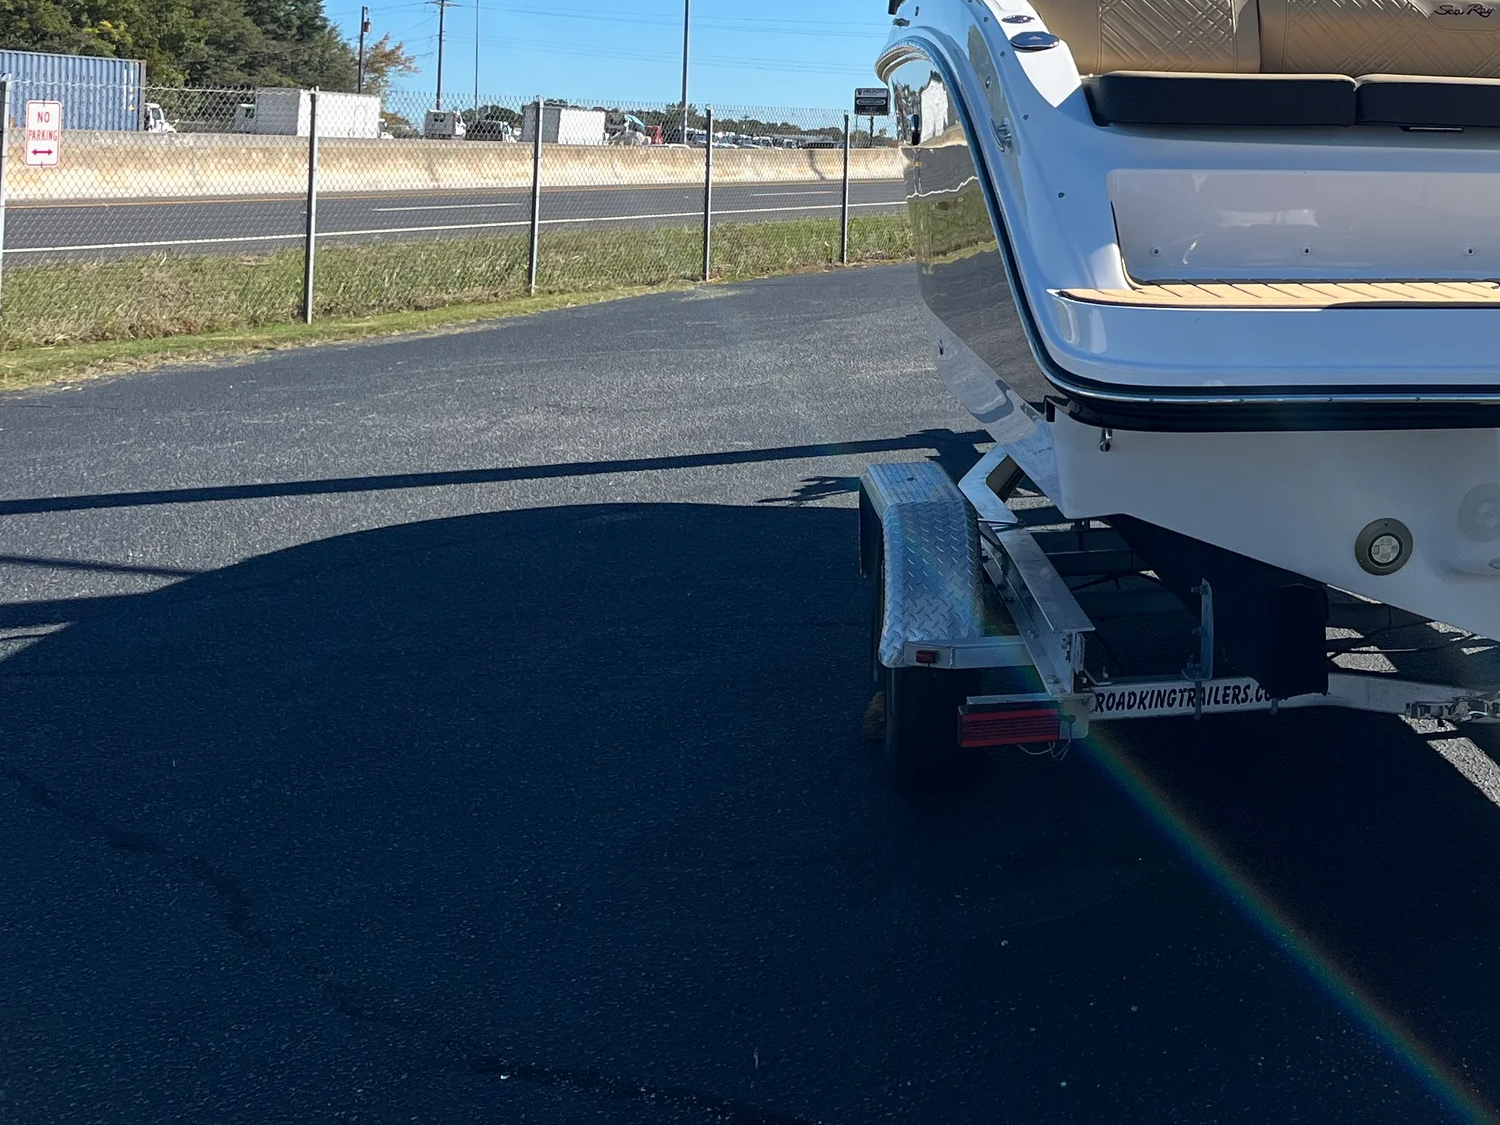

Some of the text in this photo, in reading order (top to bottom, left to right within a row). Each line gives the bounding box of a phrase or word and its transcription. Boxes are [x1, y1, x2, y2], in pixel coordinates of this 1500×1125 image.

[1434, 3, 1496, 19] Sea Ray
[37, 111, 50, 123] NO
[28, 129, 58, 142] PARKING
[1095, 682, 1274, 713] ROADKINGTRAILERS.CO
